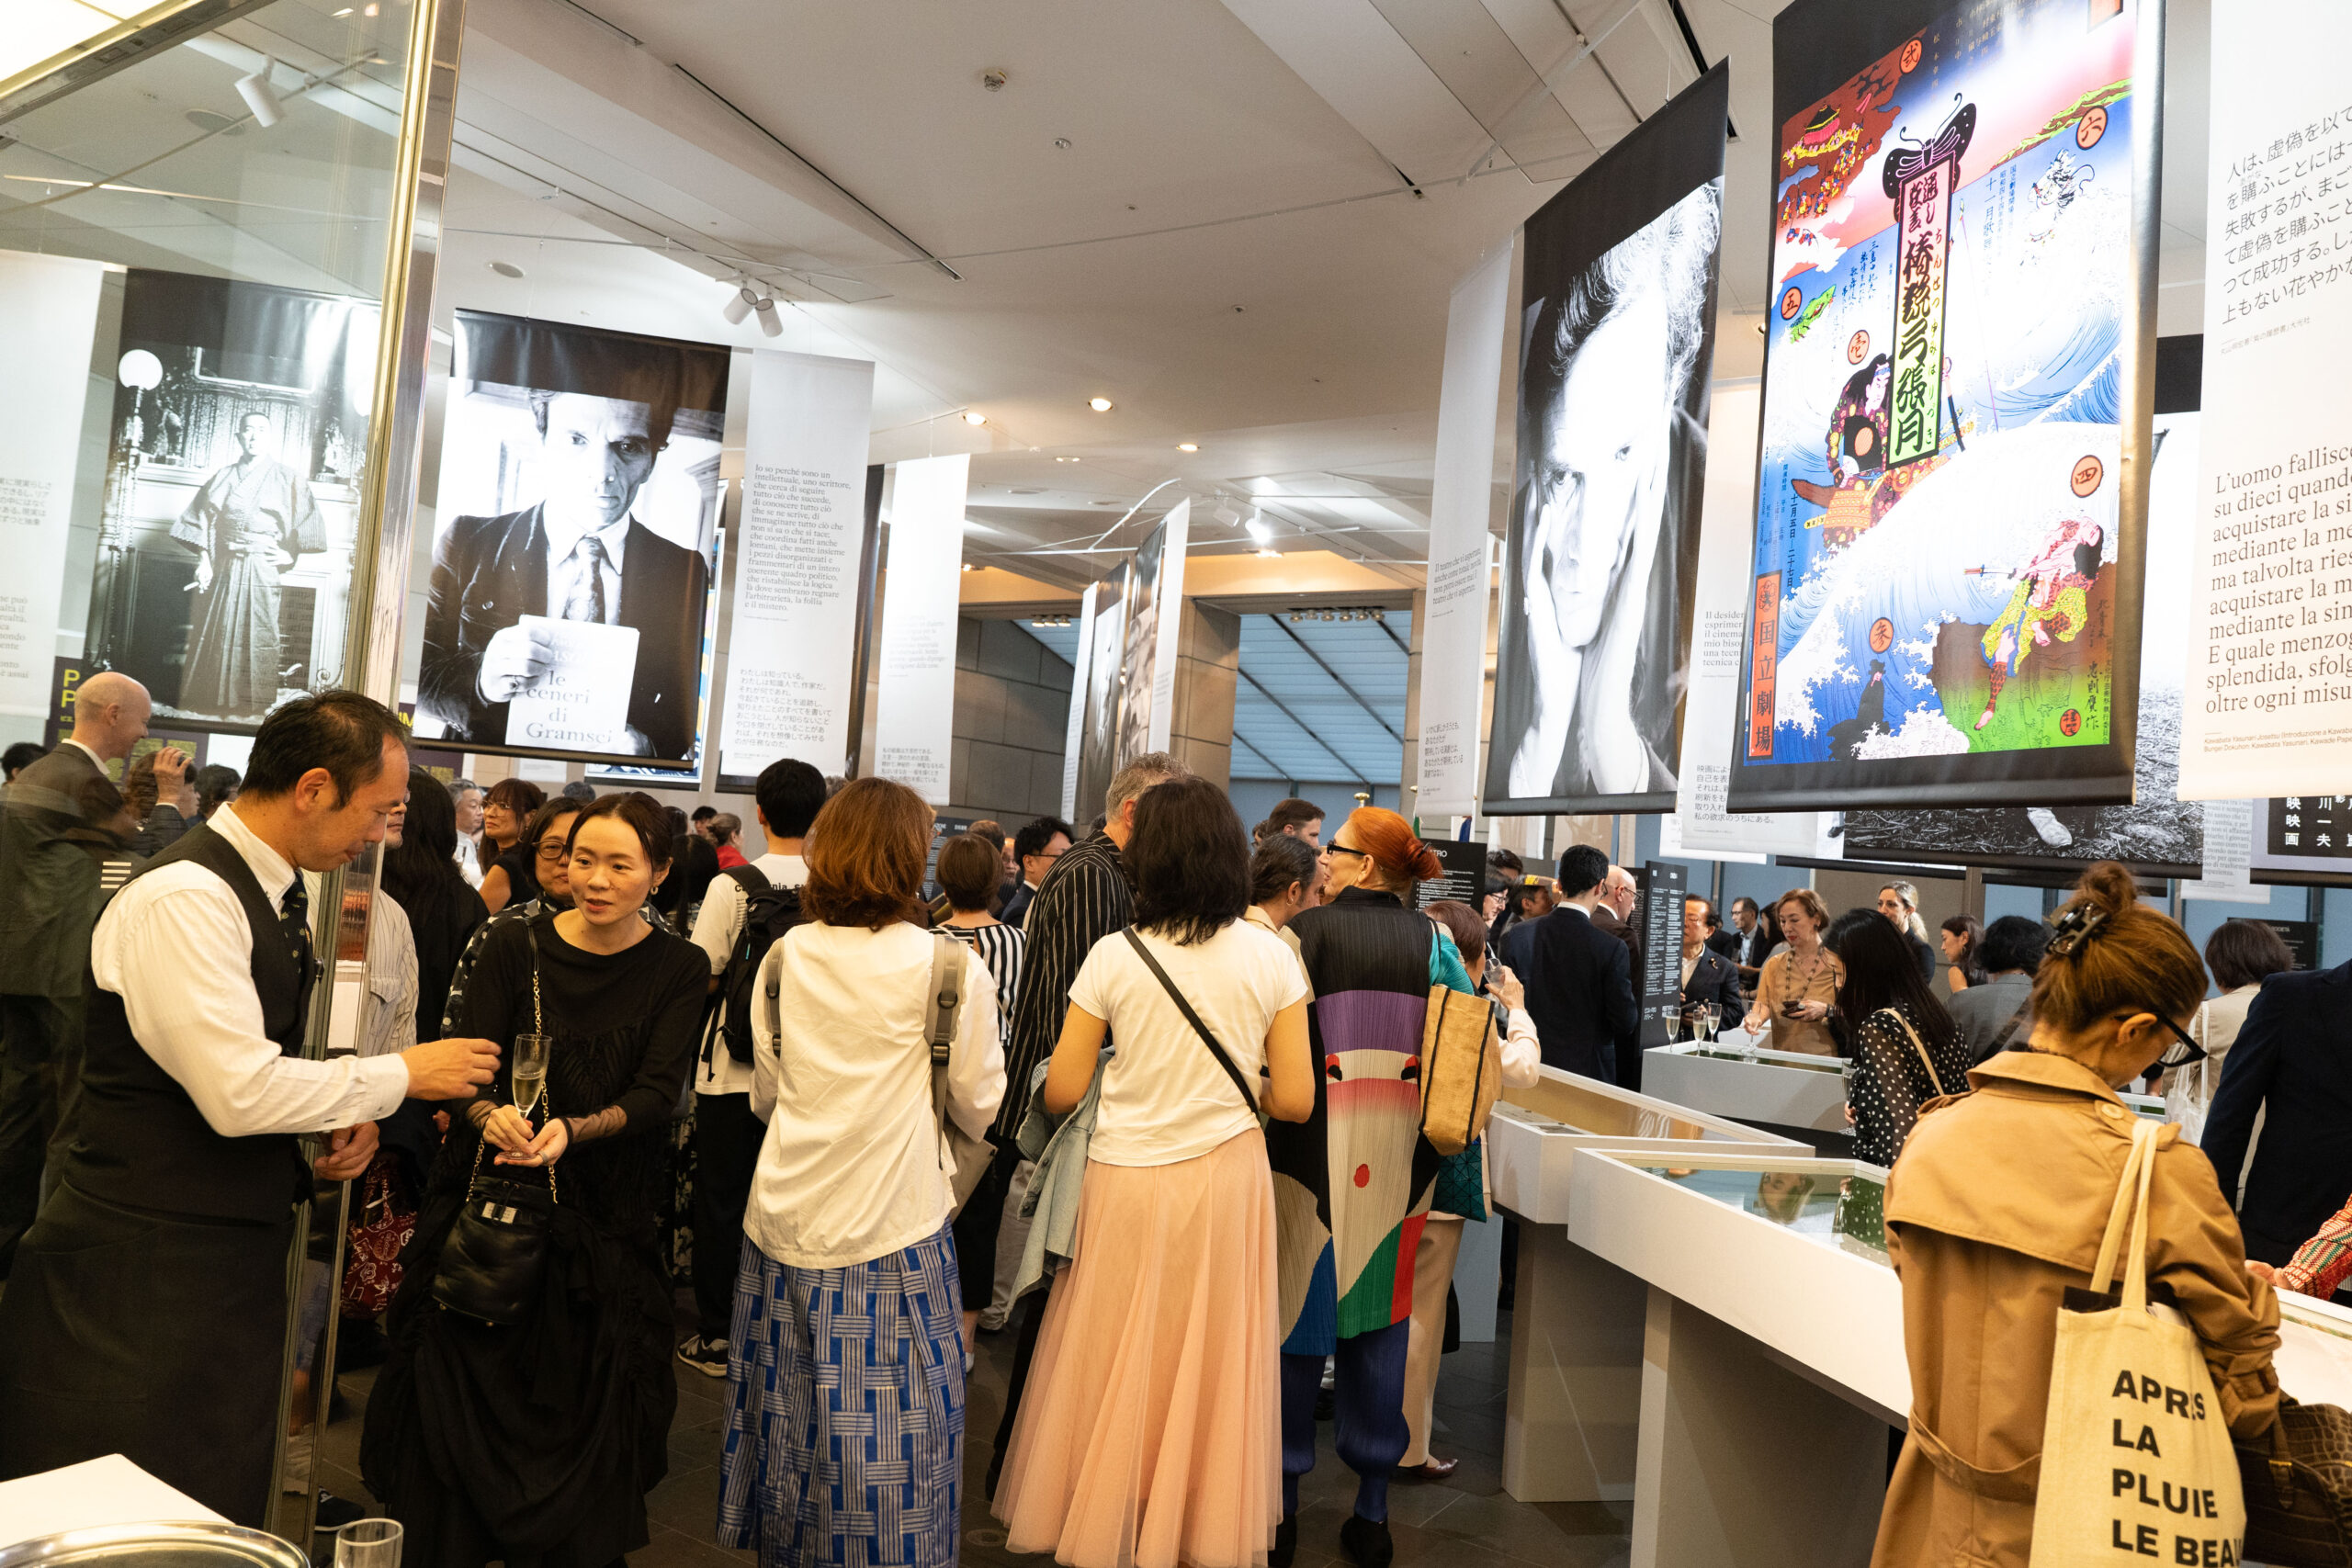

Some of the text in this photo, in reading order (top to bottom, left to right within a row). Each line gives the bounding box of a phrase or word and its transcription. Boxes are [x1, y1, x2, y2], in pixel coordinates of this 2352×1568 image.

[2080, 116, 2103, 143] 六
[2227, 141, 2352, 210] を購ふことには
[2223, 231, 2352, 294] つて成功する。し
[1785, 293, 1798, 314] 五
[775, 467, 800, 476] perché
[2075, 465, 2098, 485] 四
[2216, 446, 2352, 494] L'uomo fallisc
[753, 481, 767, 490] che
[799, 488, 825, 496] seguire
[2214, 467, 2352, 518] su dieci quand
[763, 501, 798, 510] conoscere
[800, 503, 819, 512] tutto
[752, 514, 797, 526] immaginare
[798, 520, 817, 528] tutto
[791, 527, 804, 536] che
[2213, 501, 2330, 542] acquistare la
[765, 535, 797, 544] coordina
[817, 539, 838, 547] anche
[2212, 536, 2297, 567] mediante
[2303, 528, 2320, 548] la
[747, 568, 779, 576] coerente
[748, 558, 795, 569] frammentari
[2211, 573, 2237, 592] ma
[2243, 557, 2313, 585] talvolta
[755, 584, 772, 592] dove
[775, 587, 809, 596] sembrano
[762, 577, 801, 586] ristabilisce
[2210, 586, 2303, 615] acquistare
[2310, 579, 2326, 598] la
[2209, 614, 2294, 640] mediante
[2301, 606, 2317, 626] la
[1724, 639, 1742, 648] biso
[2208, 645, 2221, 664] E
[2225, 638, 2276, 666] quale
[548, 671, 566, 686] le
[1755, 619, 1776, 752] 国立劇場
[2207, 660, 2303, 693] splendida,
[526, 688, 590, 704] ceneri
[2206, 694, 2248, 714] oltre
[2255, 686, 2297, 713] ogni
[548, 707, 567, 722] di
[526, 722, 613, 744] Gramsci
[2111, 1370, 2206, 1421] APRS
[2113, 1419, 2161, 1459] LA
[2113, 1469, 2219, 1518] PLUIE
[2113, 1519, 2159, 1558] LE
